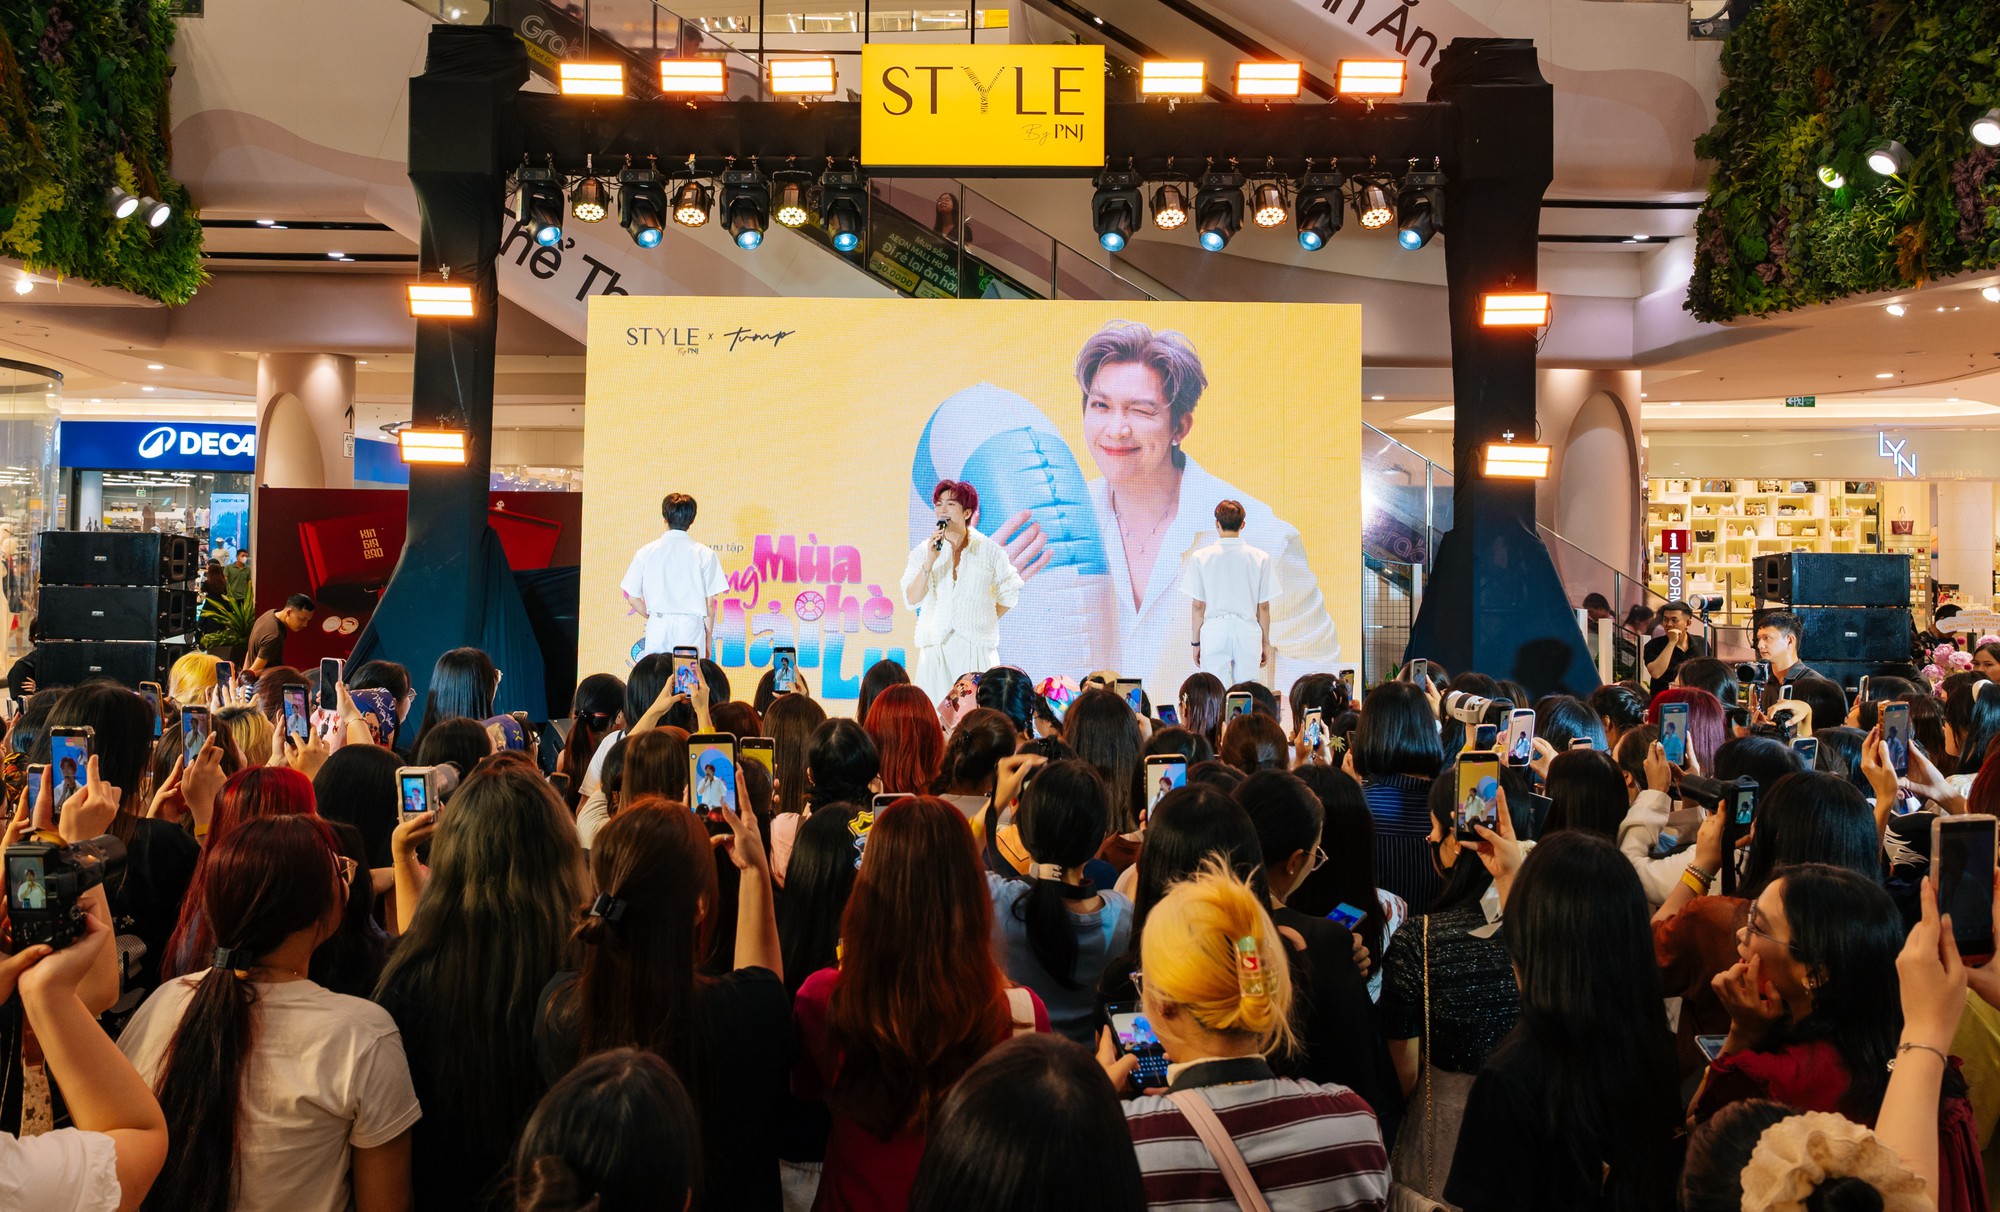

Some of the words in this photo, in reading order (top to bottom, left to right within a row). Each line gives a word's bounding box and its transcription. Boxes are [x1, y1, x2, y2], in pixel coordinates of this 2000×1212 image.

[882, 66, 1085, 116] STYLE
[1022, 123, 1050, 146] By
[1054, 123, 1084, 143] PNJ
[888, 233, 912, 250] AEON
[910, 245, 931, 263] MALL
[914, 235, 932, 251] Mua
[894, 251, 909, 263] rẻ
[908, 256, 925, 273] lại
[923, 267, 940, 283] ăn
[626, 327, 700, 346] STYLE
[687, 347, 699, 355] PNJ
[1878, 431, 1917, 477] LYN
[726, 542, 744, 553] tập
[752, 532, 862, 585] Mùa
[823, 584, 894, 634] hè
